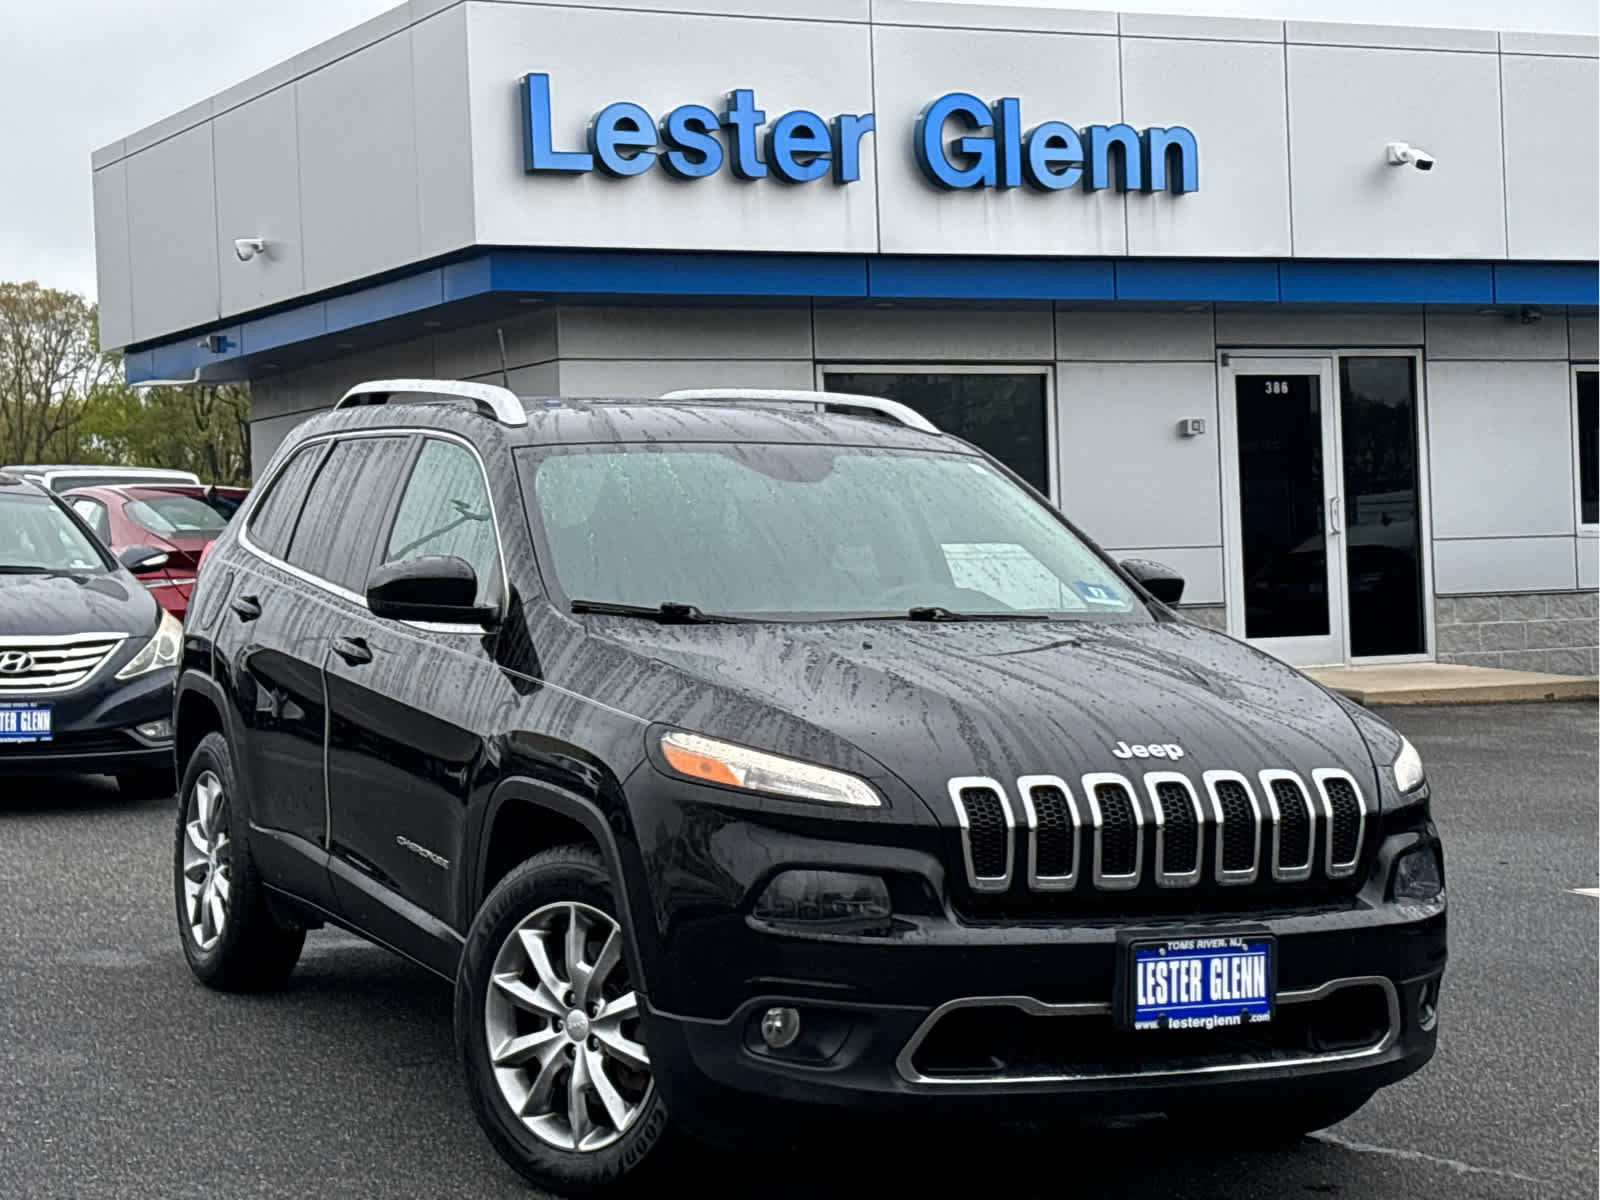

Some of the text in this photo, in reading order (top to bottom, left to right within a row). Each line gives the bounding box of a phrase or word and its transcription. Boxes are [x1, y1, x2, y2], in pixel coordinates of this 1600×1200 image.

[519, 72, 1199, 194] Lester Glenn
[21, 711, 50, 731] GLENN
[1112, 741, 1184, 760] Jeep
[1168, 941, 1195, 951] TOMS
[1137, 955, 1266, 1005] LESTER GLENN
[1168, 1015, 1241, 1030] lesterglenn
